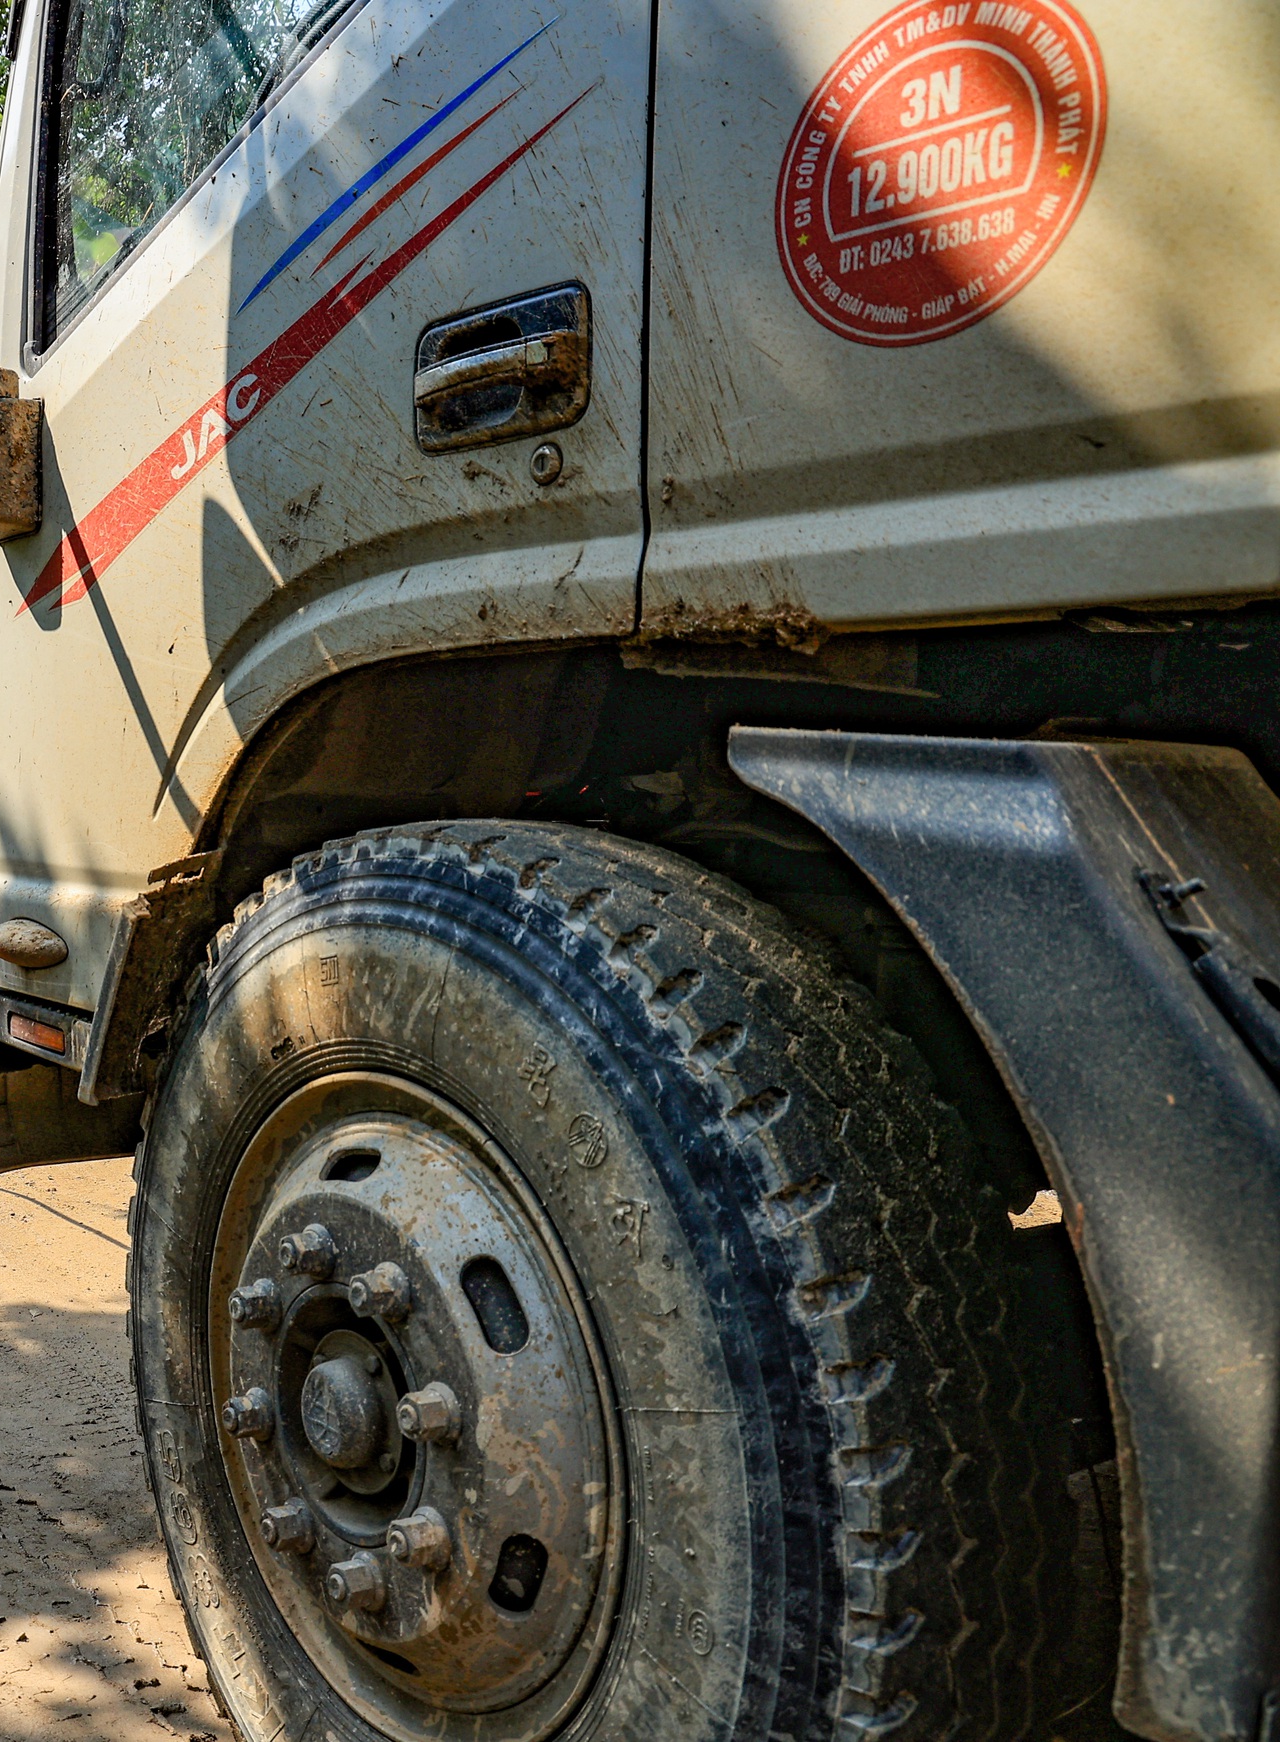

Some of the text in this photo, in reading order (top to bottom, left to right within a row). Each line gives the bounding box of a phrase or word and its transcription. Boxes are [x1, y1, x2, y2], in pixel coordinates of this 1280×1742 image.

[794, 2, 1085, 228] CN CÔNG TY TNHH TM&DV MINH THÀNH PHÁT
[900, 64, 962, 128] 3N
[847, 121, 1014, 217] 12.900KG
[819, 275, 841, 302] 789
[1036, 193, 1061, 220] HN
[870, 233, 914, 266] 0243
[920, 207, 1015, 254] 7.638.638
[171, 373, 261, 480] JAC
